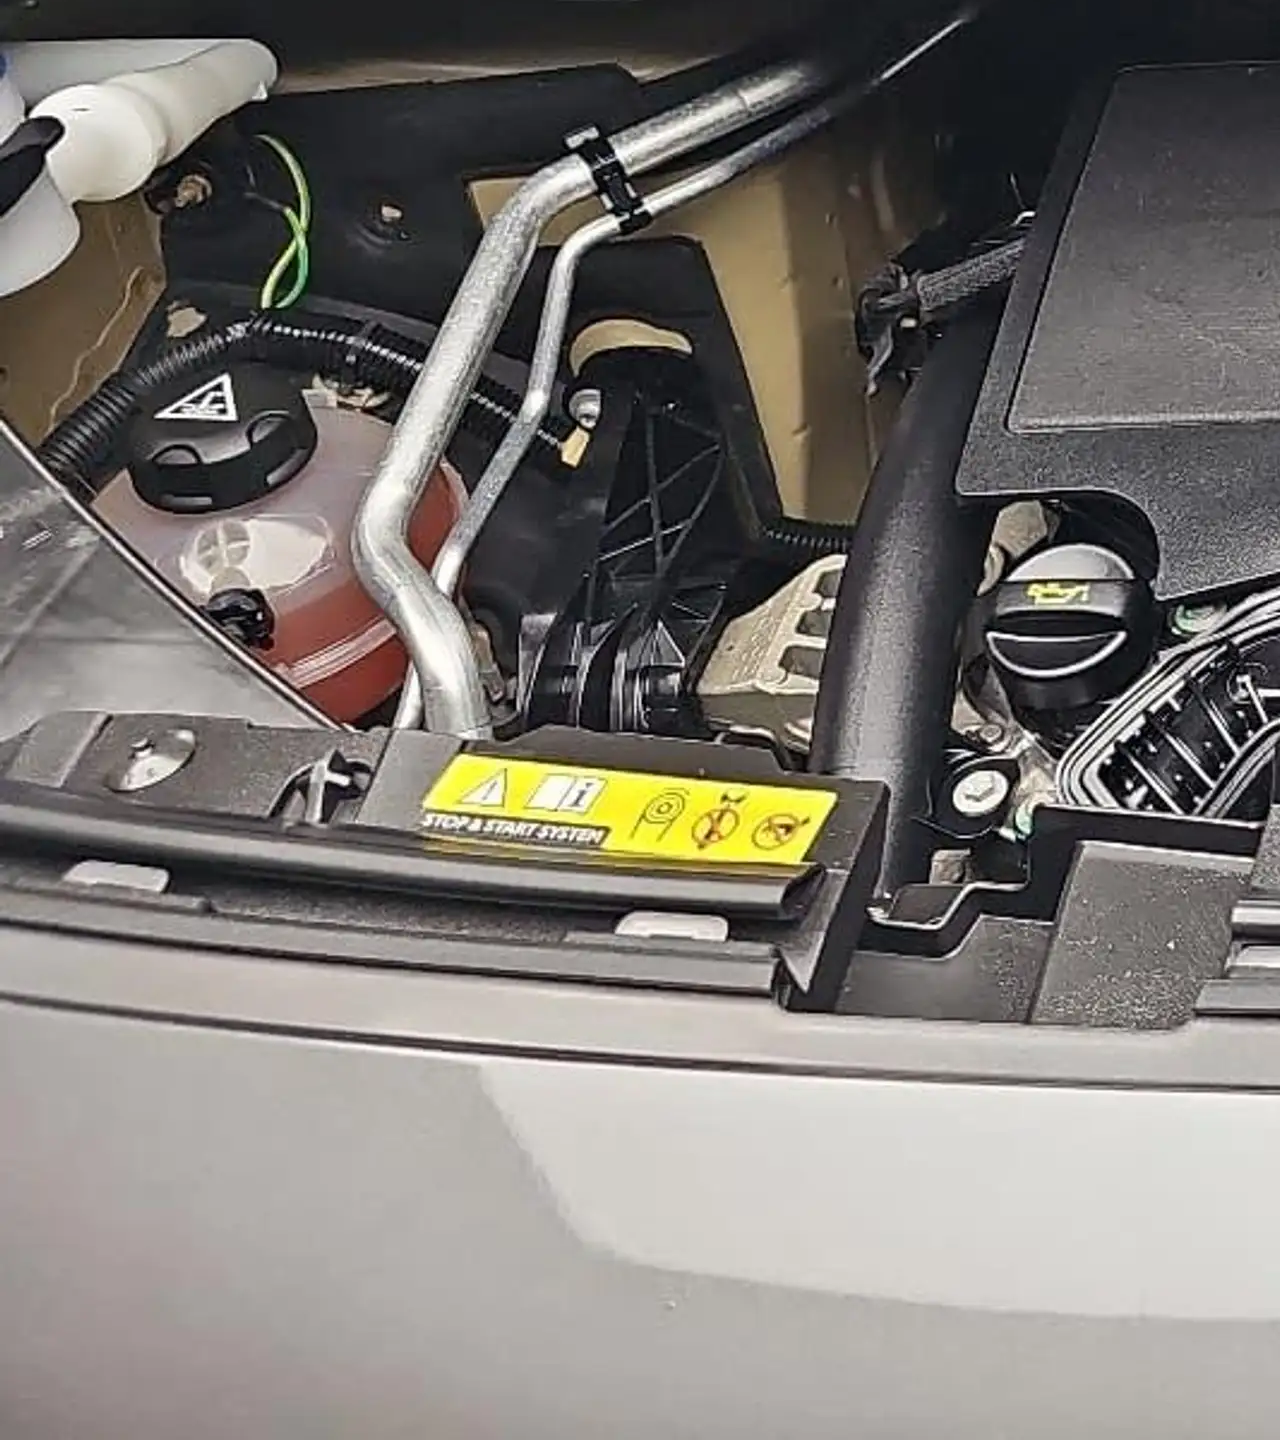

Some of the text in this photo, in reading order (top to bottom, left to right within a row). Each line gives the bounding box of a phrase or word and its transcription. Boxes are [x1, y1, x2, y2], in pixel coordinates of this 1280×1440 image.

[422, 812, 468, 830] STOP
[483, 820, 536, 838] START
[537, 825, 604, 843] SYSTEM
